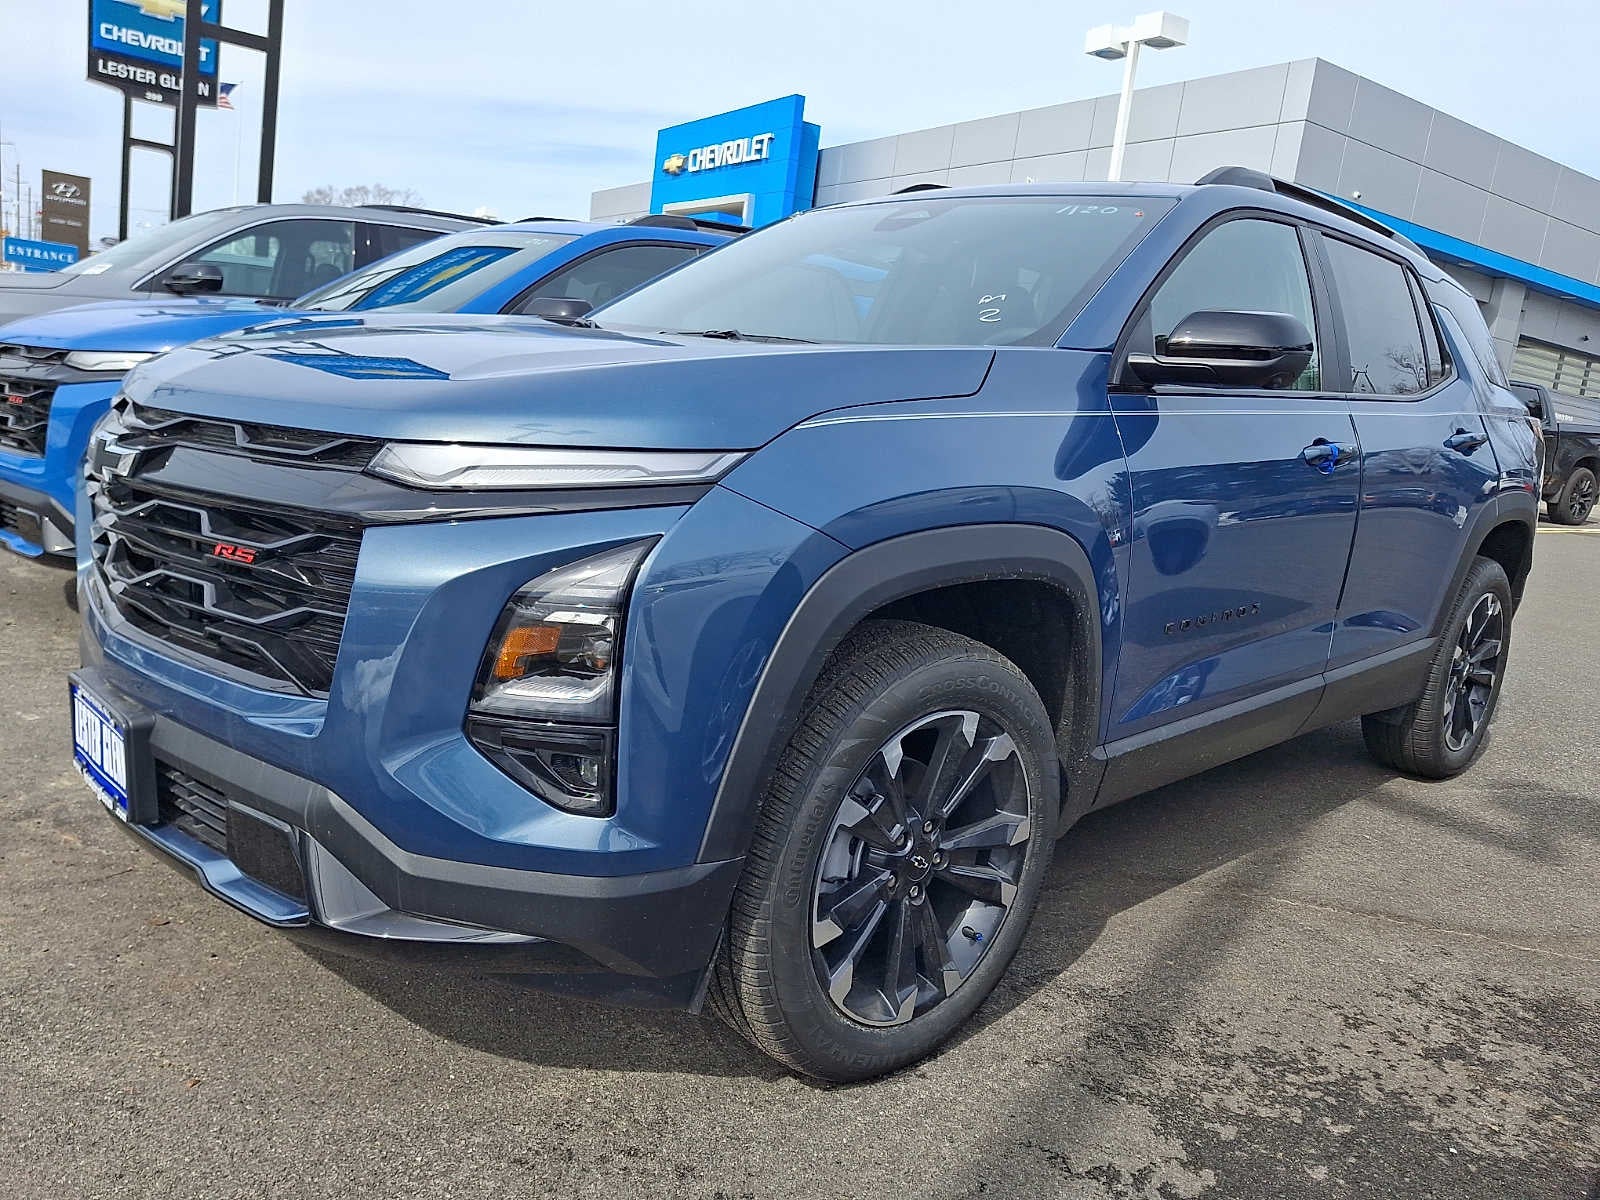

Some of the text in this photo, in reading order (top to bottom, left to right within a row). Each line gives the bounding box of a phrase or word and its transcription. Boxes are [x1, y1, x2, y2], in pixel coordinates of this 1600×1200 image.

[100, 23, 210, 61] CHEVROLT
[98, 59, 210, 97] LESTER GLN
[687, 132, 774, 173] CHEVROLET
[8, 245, 75, 264] ENTRANCE
[213, 543, 257, 564] RS
